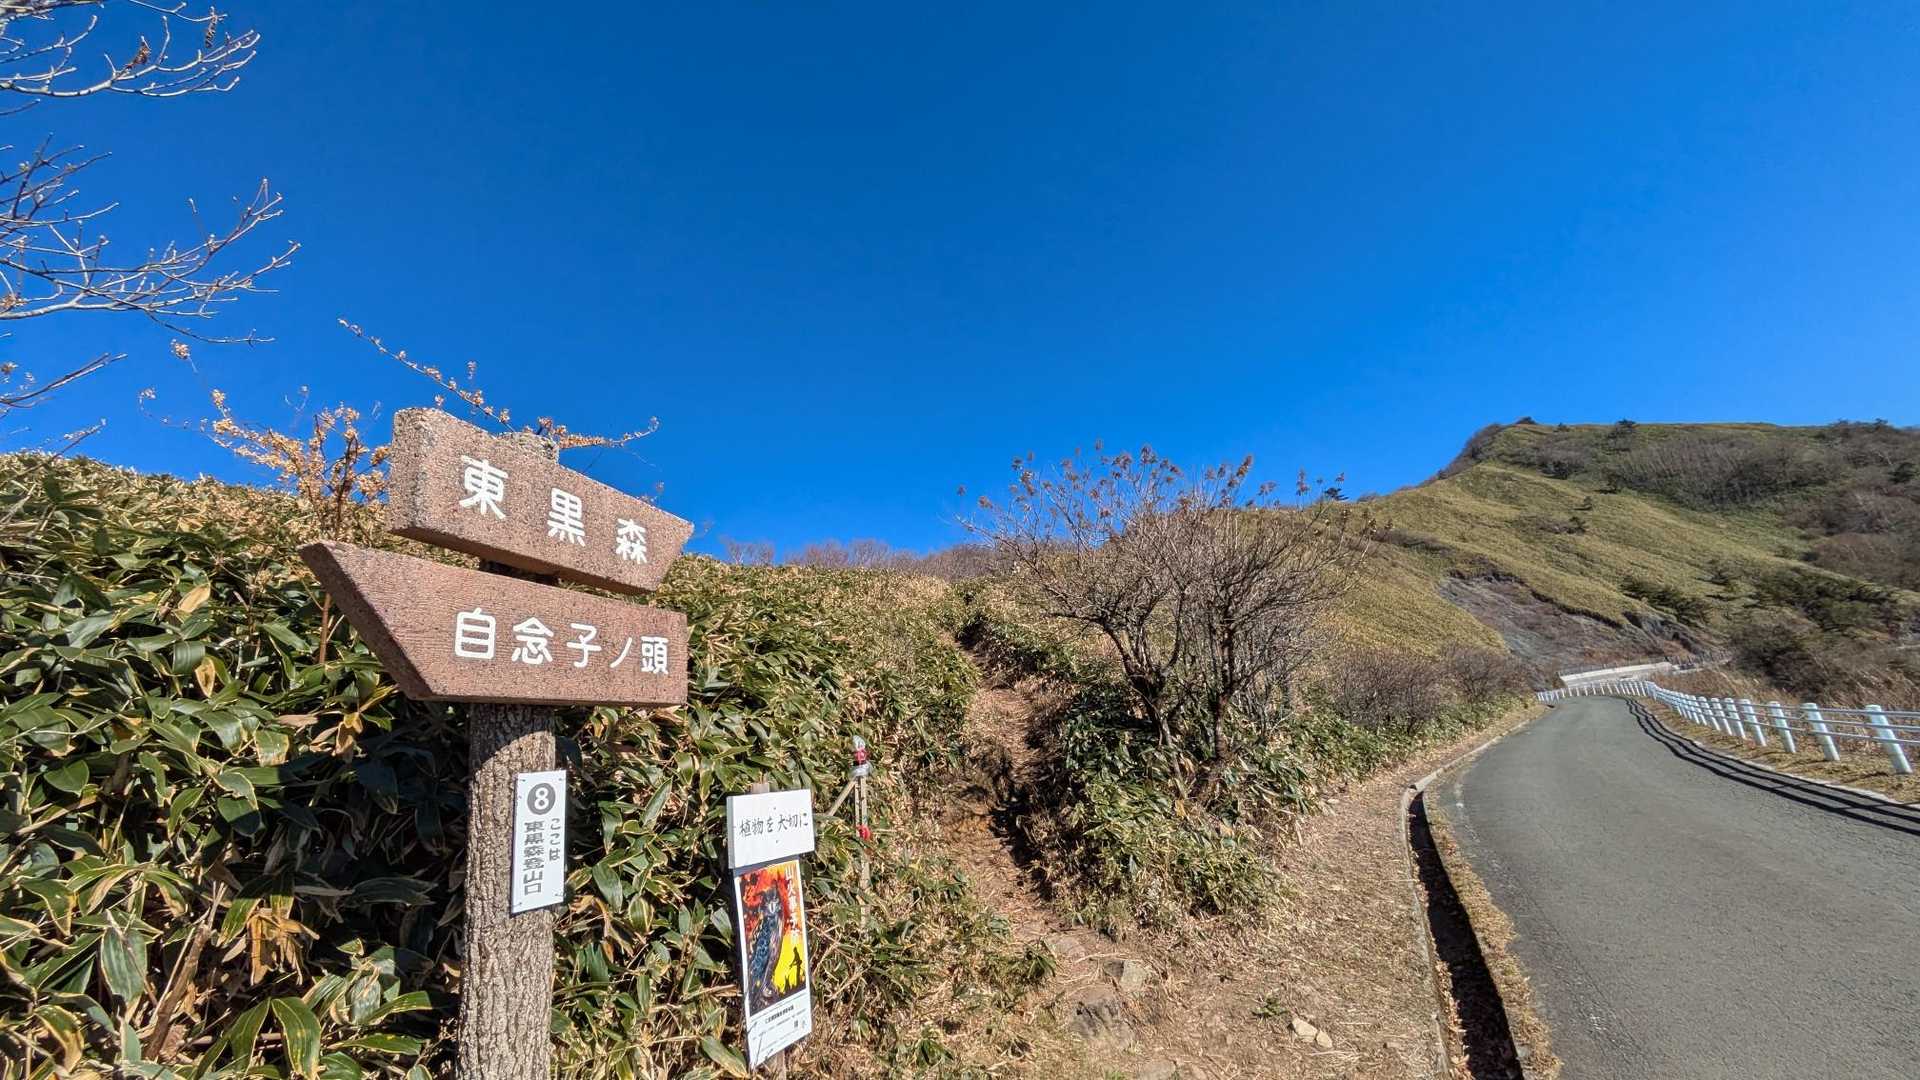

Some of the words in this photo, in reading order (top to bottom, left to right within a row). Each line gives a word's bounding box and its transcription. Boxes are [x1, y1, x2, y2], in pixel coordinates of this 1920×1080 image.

[459, 455, 648, 565] 東黒森
[455, 607, 669, 676] 自念子ノ頭
[523, 819, 545, 896] 東黒森登山口
[549, 817, 561, 862] ここは
[739, 812, 808, 837] 植物を大切に
